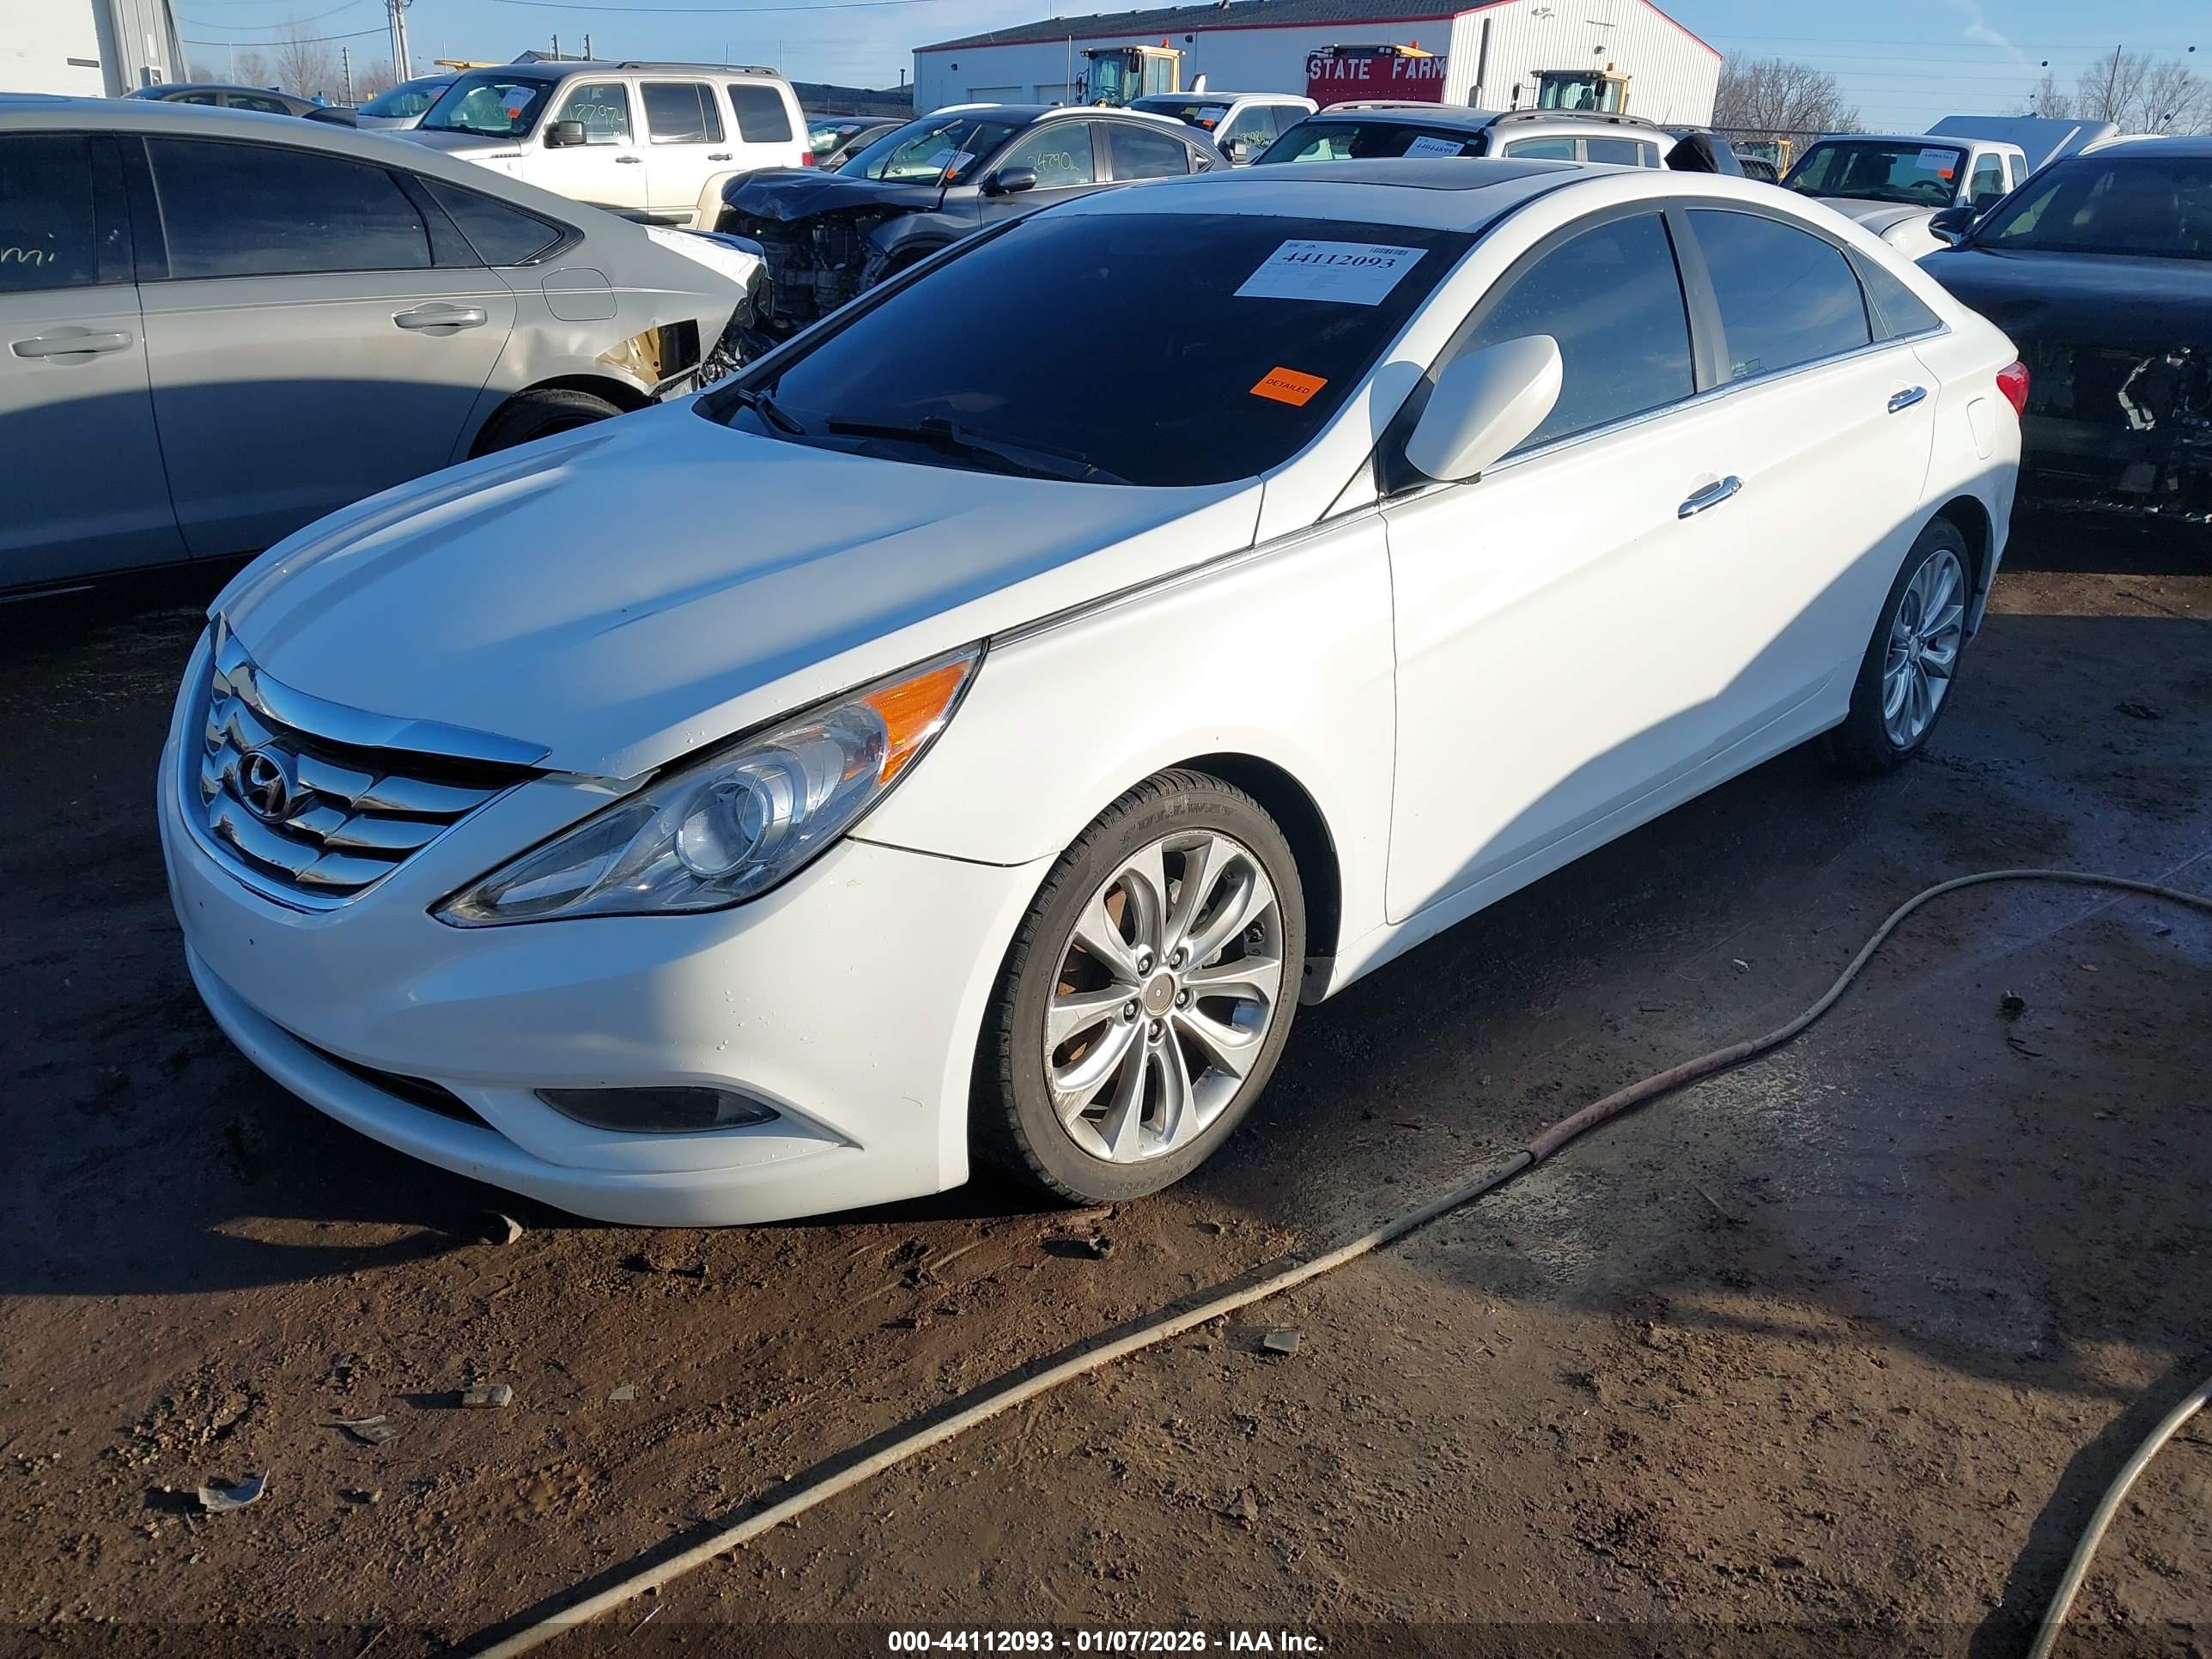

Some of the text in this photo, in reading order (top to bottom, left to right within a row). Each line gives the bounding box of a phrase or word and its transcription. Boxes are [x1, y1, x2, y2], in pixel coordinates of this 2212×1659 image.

[1310, 58, 1447, 80] STATE FARM
[1282, 252, 1397, 269] 44112093
[1266, 378, 1310, 394] DETAILED
